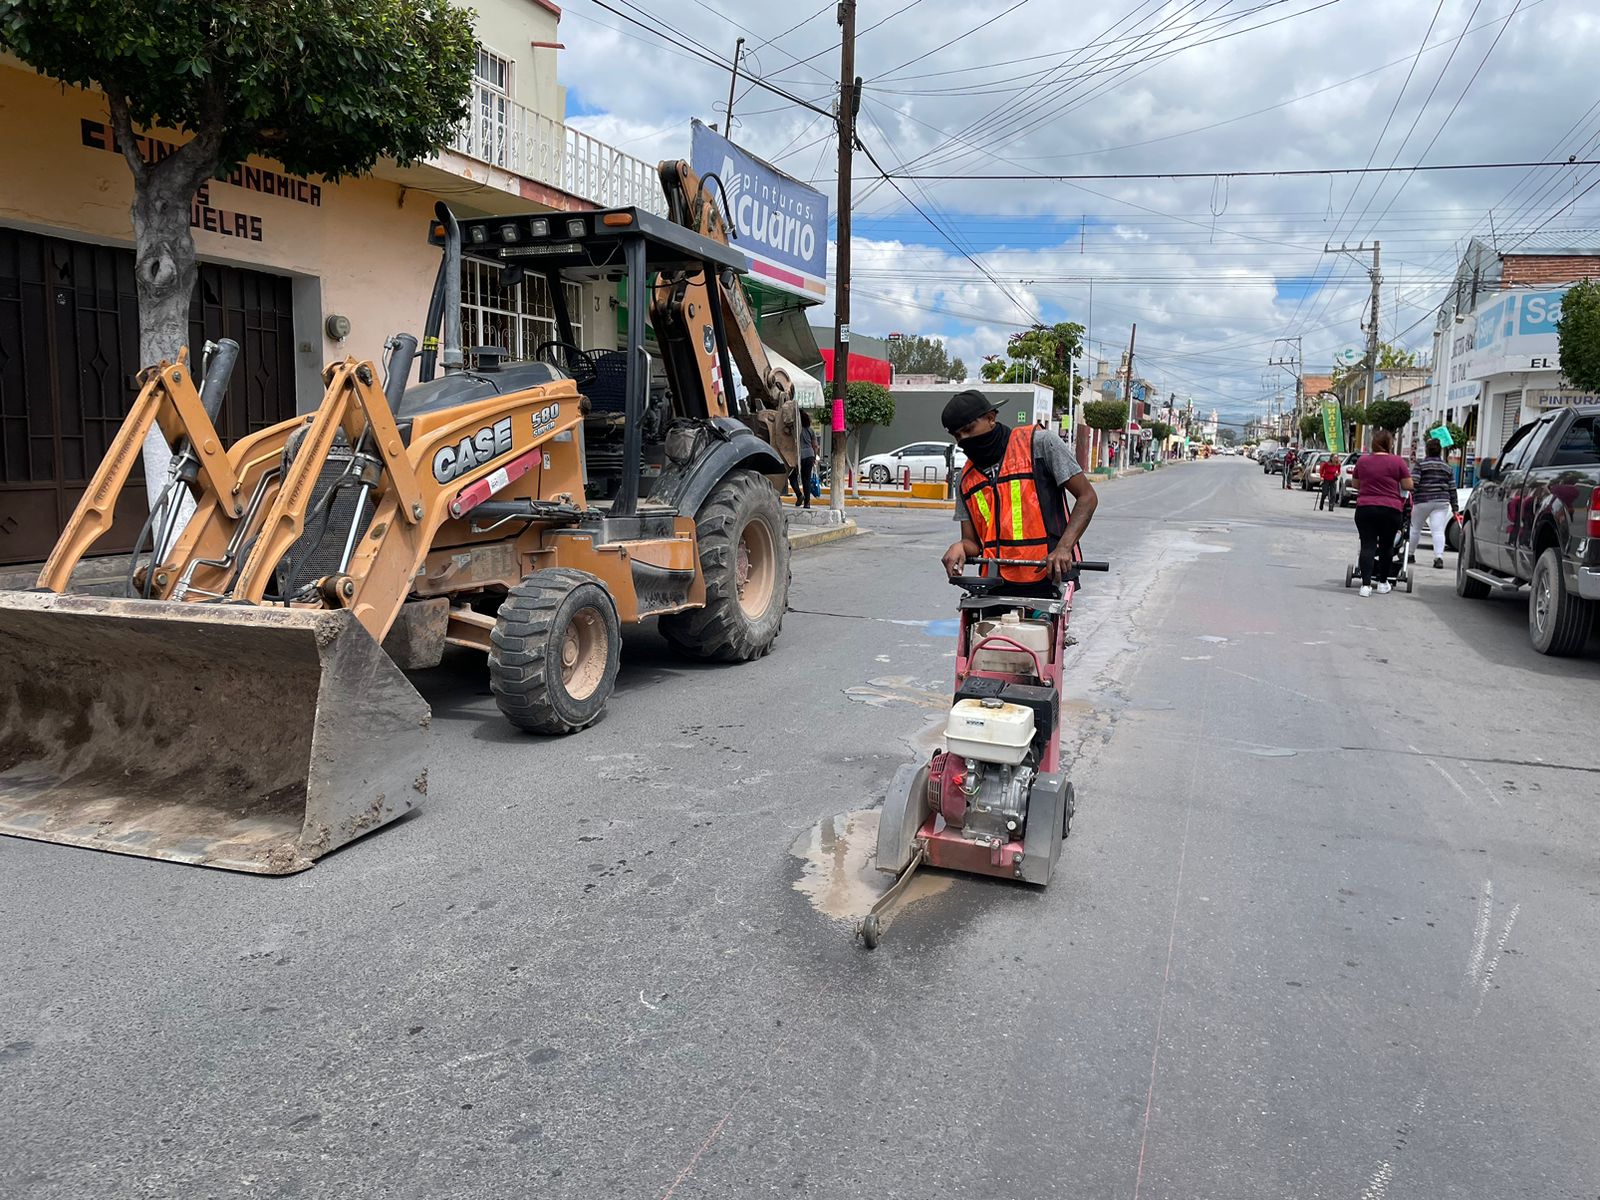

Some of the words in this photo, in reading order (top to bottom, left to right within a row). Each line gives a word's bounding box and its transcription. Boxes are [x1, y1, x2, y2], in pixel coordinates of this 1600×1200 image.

[230, 162, 321, 207] ONOMICA
[743, 172, 811, 220] pinturas
[190, 203, 263, 242] UELAS
[1531, 358, 1551, 368] EL
[531, 402, 560, 429] 580
[433, 416, 512, 484] CASE
